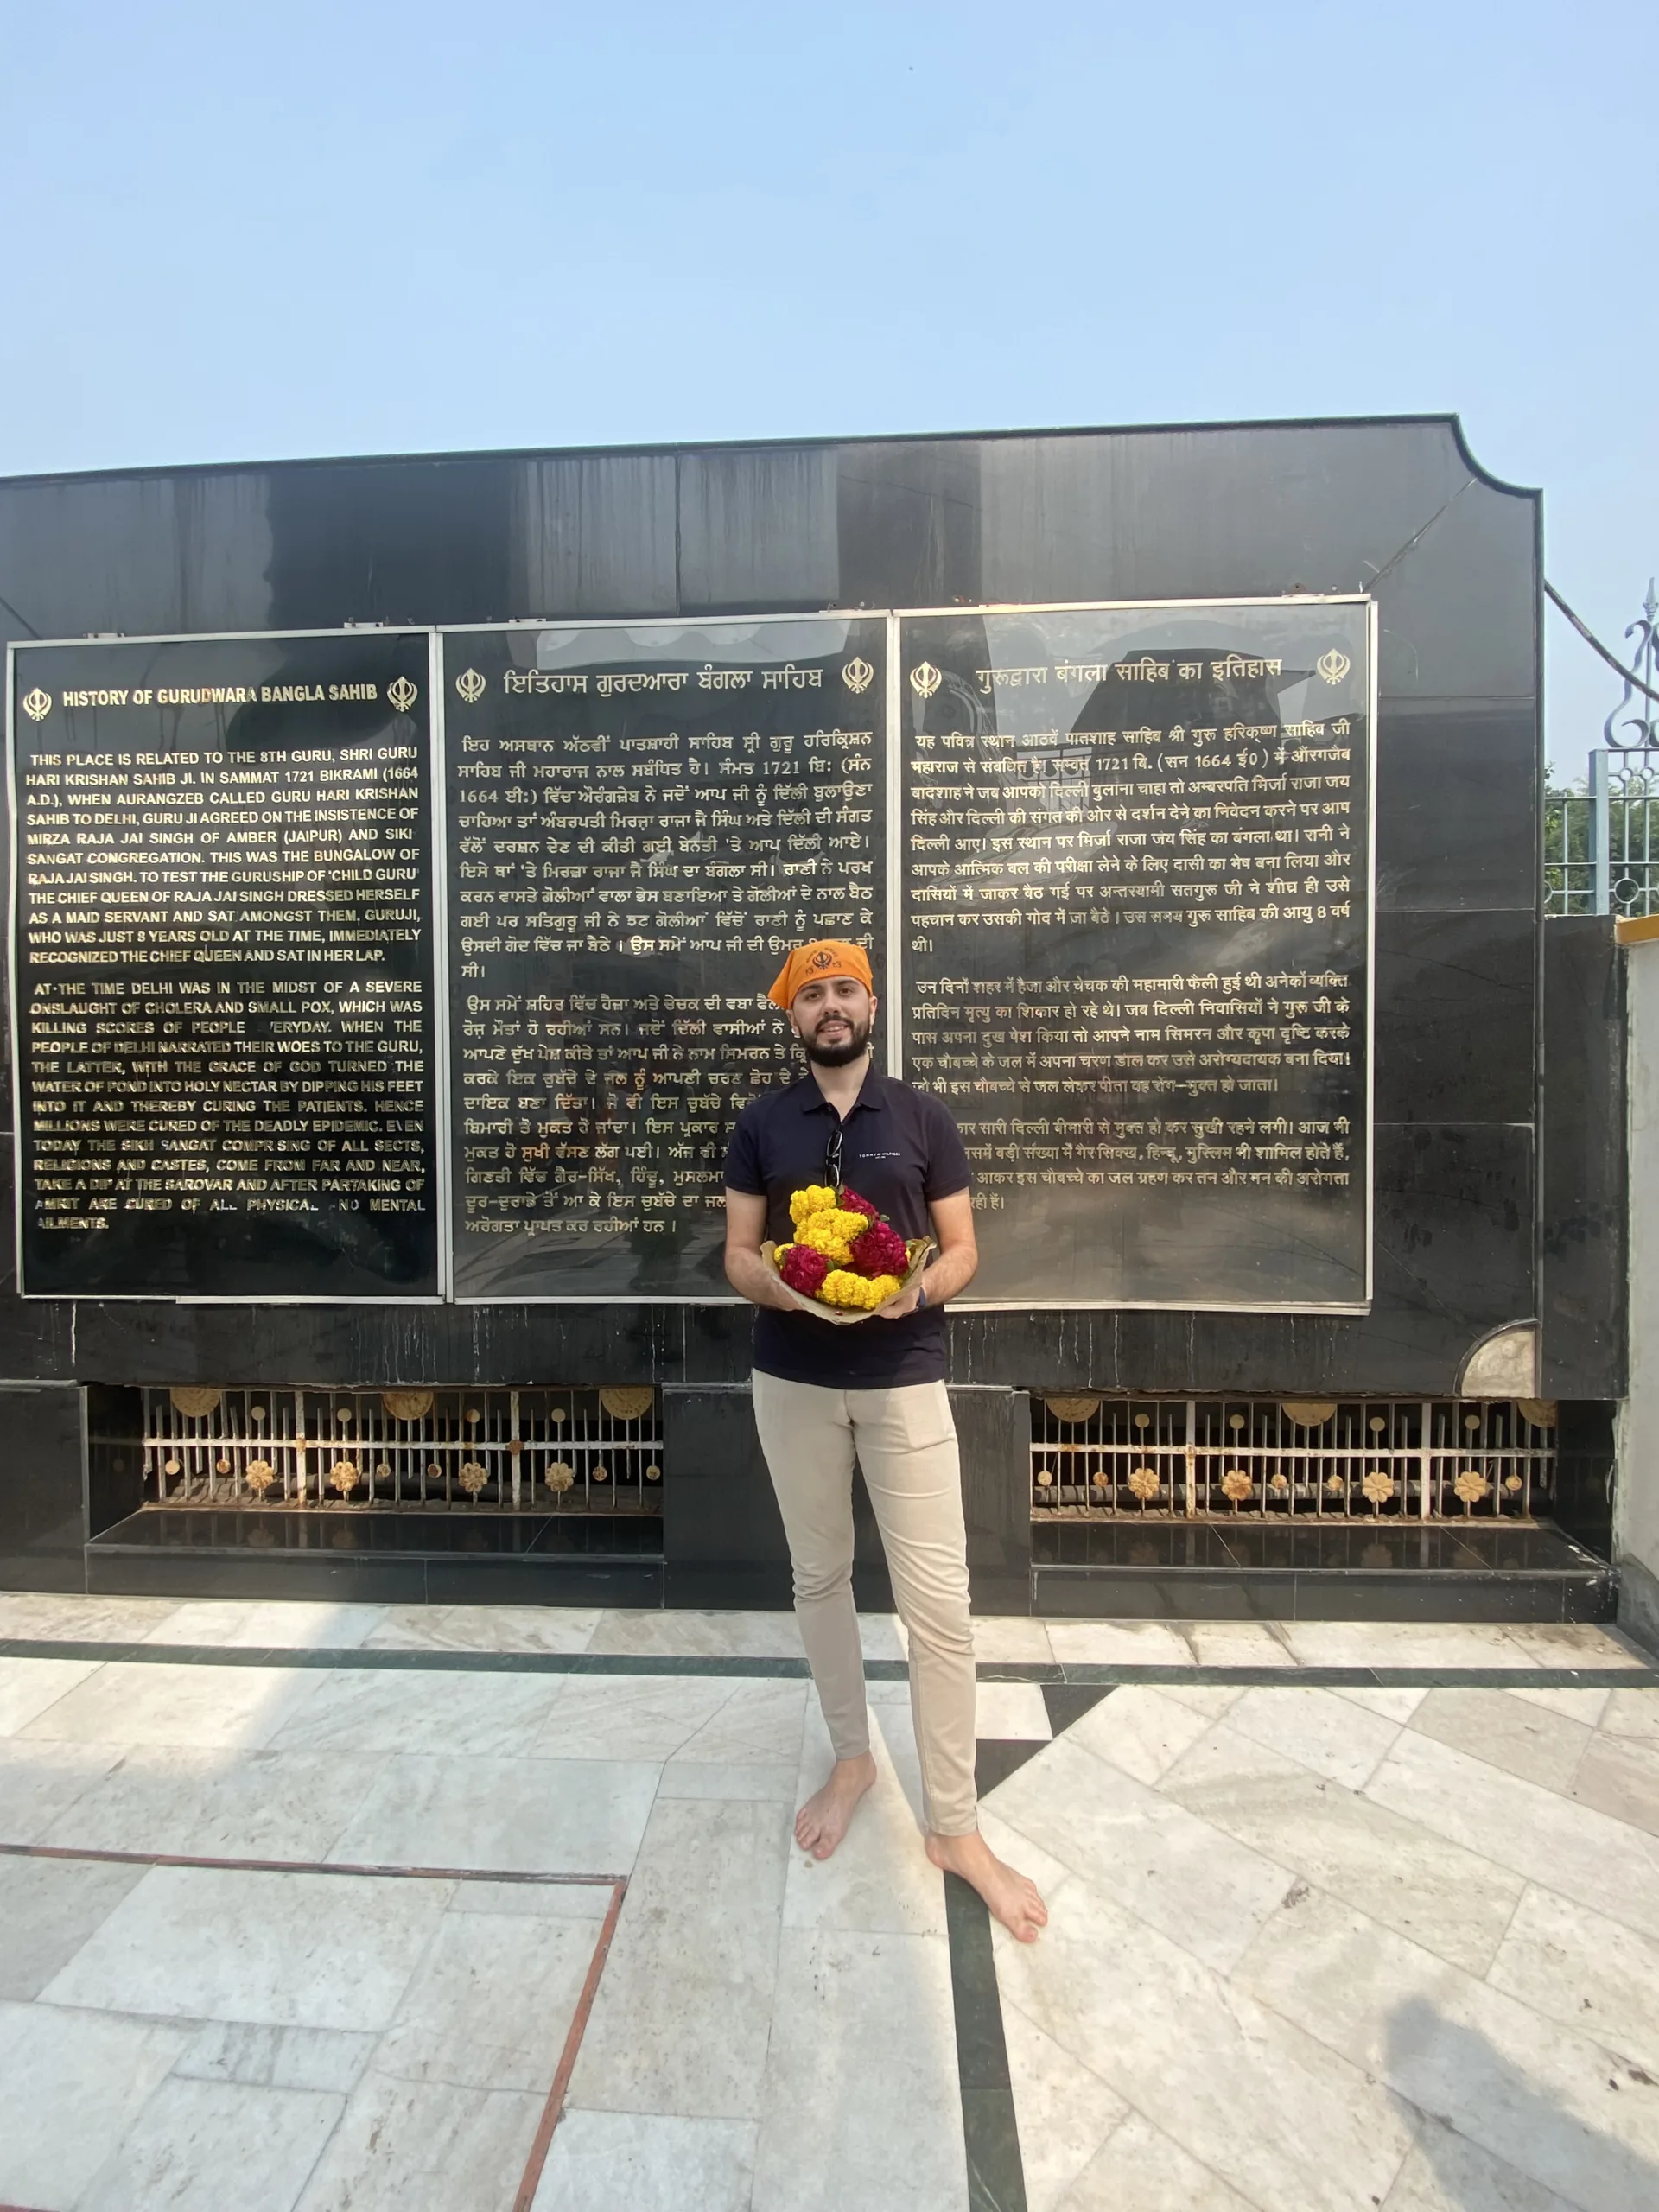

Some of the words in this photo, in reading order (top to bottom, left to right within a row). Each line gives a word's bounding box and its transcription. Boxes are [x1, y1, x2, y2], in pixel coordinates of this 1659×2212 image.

[1054, 659, 1108, 683] बंगला
[1114, 657, 1171, 683] साहिब
[1177, 662, 1203, 680] का
[1210, 653, 1282, 682] इतिहास
[63, 690, 128, 707] HISTORY
[132, 690, 152, 705] OF
[157, 687, 257, 704] GURUDWARA
[261, 685, 325, 702] BANGLA
[329, 683, 377, 701] SAHIB
[914, 735, 935, 749] यह
[940, 728, 975, 748] पवित्र
[980, 735, 1014, 750] स्थान
[1065, 725, 1116, 746] पातशाह
[1122, 726, 1161, 745] साहिब
[1168, 725, 1185, 742] श्री
[1191, 728, 1217, 745] गुरू
[1331, 719, 1350, 734] जी
[30, 754, 61, 766] THIS
[67, 753, 113, 766] PLACE
[118, 753, 130, 766] IS
[136, 752, 198, 765] RELATED
[203, 752, 222, 764] TO
[227, 751, 255, 763] THE
[260, 750, 286, 763] 8TH
[291, 749, 334, 762] GURU,
[340, 748, 372, 761] SHRI
[377, 747, 416, 760] GURU
[26, 774, 59, 785] HARI
[65, 774, 128, 785] KRISHAN
[133, 773, 175, 785] SAHIB
[180, 772, 195, 785] JI.
[200, 772, 214, 784] IN
[219, 772, 279, 784] SAMMAT
[285, 770, 313, 783] 1721
[320, 768, 377, 781] BIKRAMI
[383, 766, 418, 781] (1664
[27, 794, 61, 808] A.D.),
[67, 793, 110, 805] WHEN
[116, 792, 203, 805] AURANGZEB
[209, 791, 264, 804] CALLED
[271, 790, 310, 803] GURU
[316, 789, 349, 801] HARI
[355, 787, 417, 800] KRISHAN
[26, 813, 69, 825] SAHIB
[72, 813, 91, 824] TO
[94, 813, 139, 826] DELHI,
[143, 813, 182, 824] GURU
[186, 813, 197, 824] JI
[200, 811, 258, 823] AGREED
[261, 811, 281, 823] ON
[284, 810, 311, 823] THE
[315, 808, 396, 822] INSISTENCE
[399, 807, 418, 819] OF
[34, 982, 52, 995] AT
[58, 982, 86, 995] THE
[92, 982, 124, 995] TIME
[131, 982, 172, 995] DELHI
[179, 982, 210, 994] WAS
[217, 982, 230, 994] IN
[237, 982, 264, 994] THE
[272, 982, 316, 993] MIDST
[324, 982, 343, 993] OF
[349, 981, 359, 993] A
[365, 981, 422, 993] SEVERE
[911, 1003, 960, 1020] प्रतिदिन
[963, 1007, 990, 1023] मृत्यु
[995, 1007, 1012, 1018] का
[1016, 1002, 1059, 1018] शिकार
[1063, 1001, 1077, 1019] हो
[1080, 1001, 1098, 1018] रहे
[1124, 1004, 1148, 1016] जब
[1152, 1000, 1194, 1016] दिल्ली
[1198, 999, 1262, 1015] निवासियों
[1267, 999, 1279, 1014] ने
[1282, 1001, 1308, 1019] गुरू
[1312, 998, 1331, 1014] जी
[1334, 997, 1350, 1014] के
[34, 1159, 111, 1171] RELIGIONS
[116, 1159, 145, 1174] AND
[216, 1159, 257, 1171] COME
[264, 1159, 304, 1172] FROM
[312, 1160, 340, 1172] FAR
[346, 1160, 375, 1172] AND
[976, 1172, 1014, 1184] आकर
[1015, 1172, 1037, 1185] इस
[1085, 1172, 1104, 1184] का
[1107, 1172, 1133, 1184] जल
[1135, 1172, 1167, 1185] ग्रहण
[1171, 1173, 1193, 1185] कर
[1195, 1173, 1217, 1185] तन
[1220, 1170, 1247, 1185] और
[1248, 1172, 1271, 1185] मन
[1273, 1170, 1293, 1185] की
[1296, 1170, 1349, 1185] अरोगता
